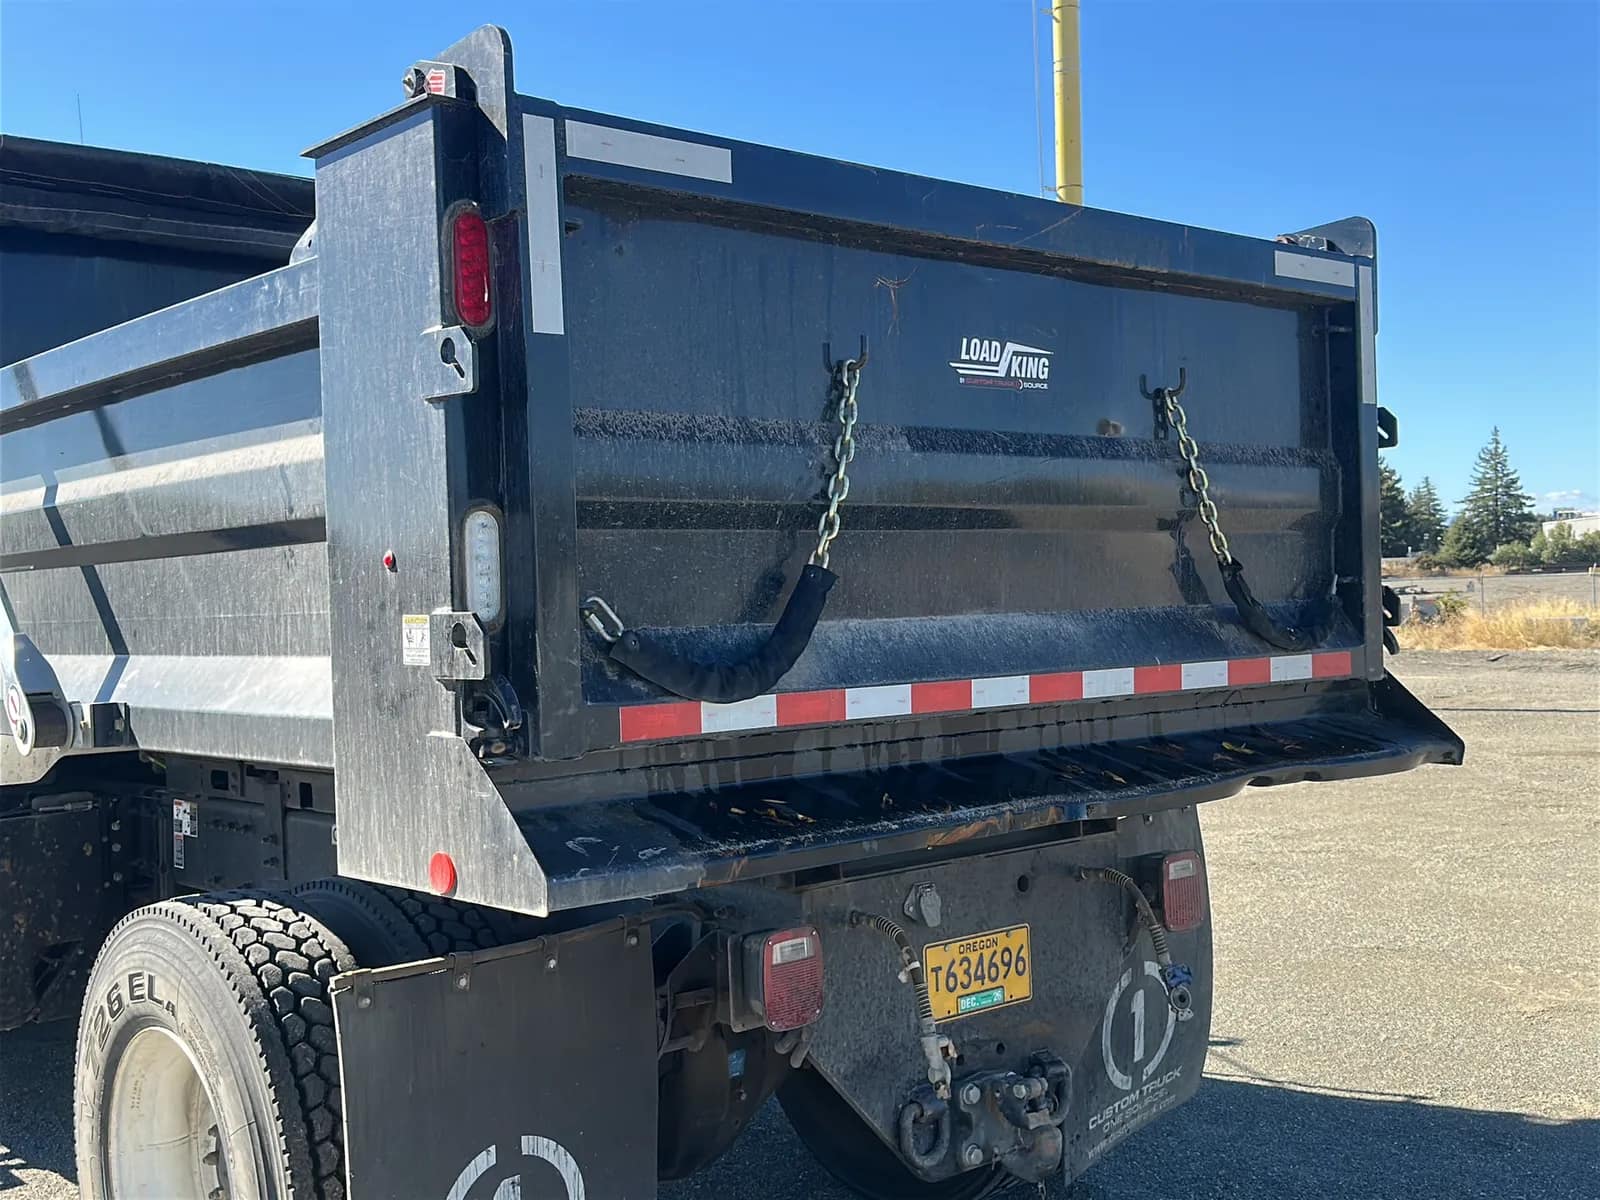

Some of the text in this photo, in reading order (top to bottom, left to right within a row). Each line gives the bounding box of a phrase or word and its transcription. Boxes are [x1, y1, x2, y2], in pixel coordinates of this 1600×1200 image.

[961, 338, 1000, 362] LOAD
[1011, 355, 1049, 379] KING
[959, 937, 998, 955] OREGON
[931, 944, 1026, 992] T634696
[1088, 1089, 1140, 1130] CUSTOM
[1141, 1065, 1183, 1096] TRUCK
